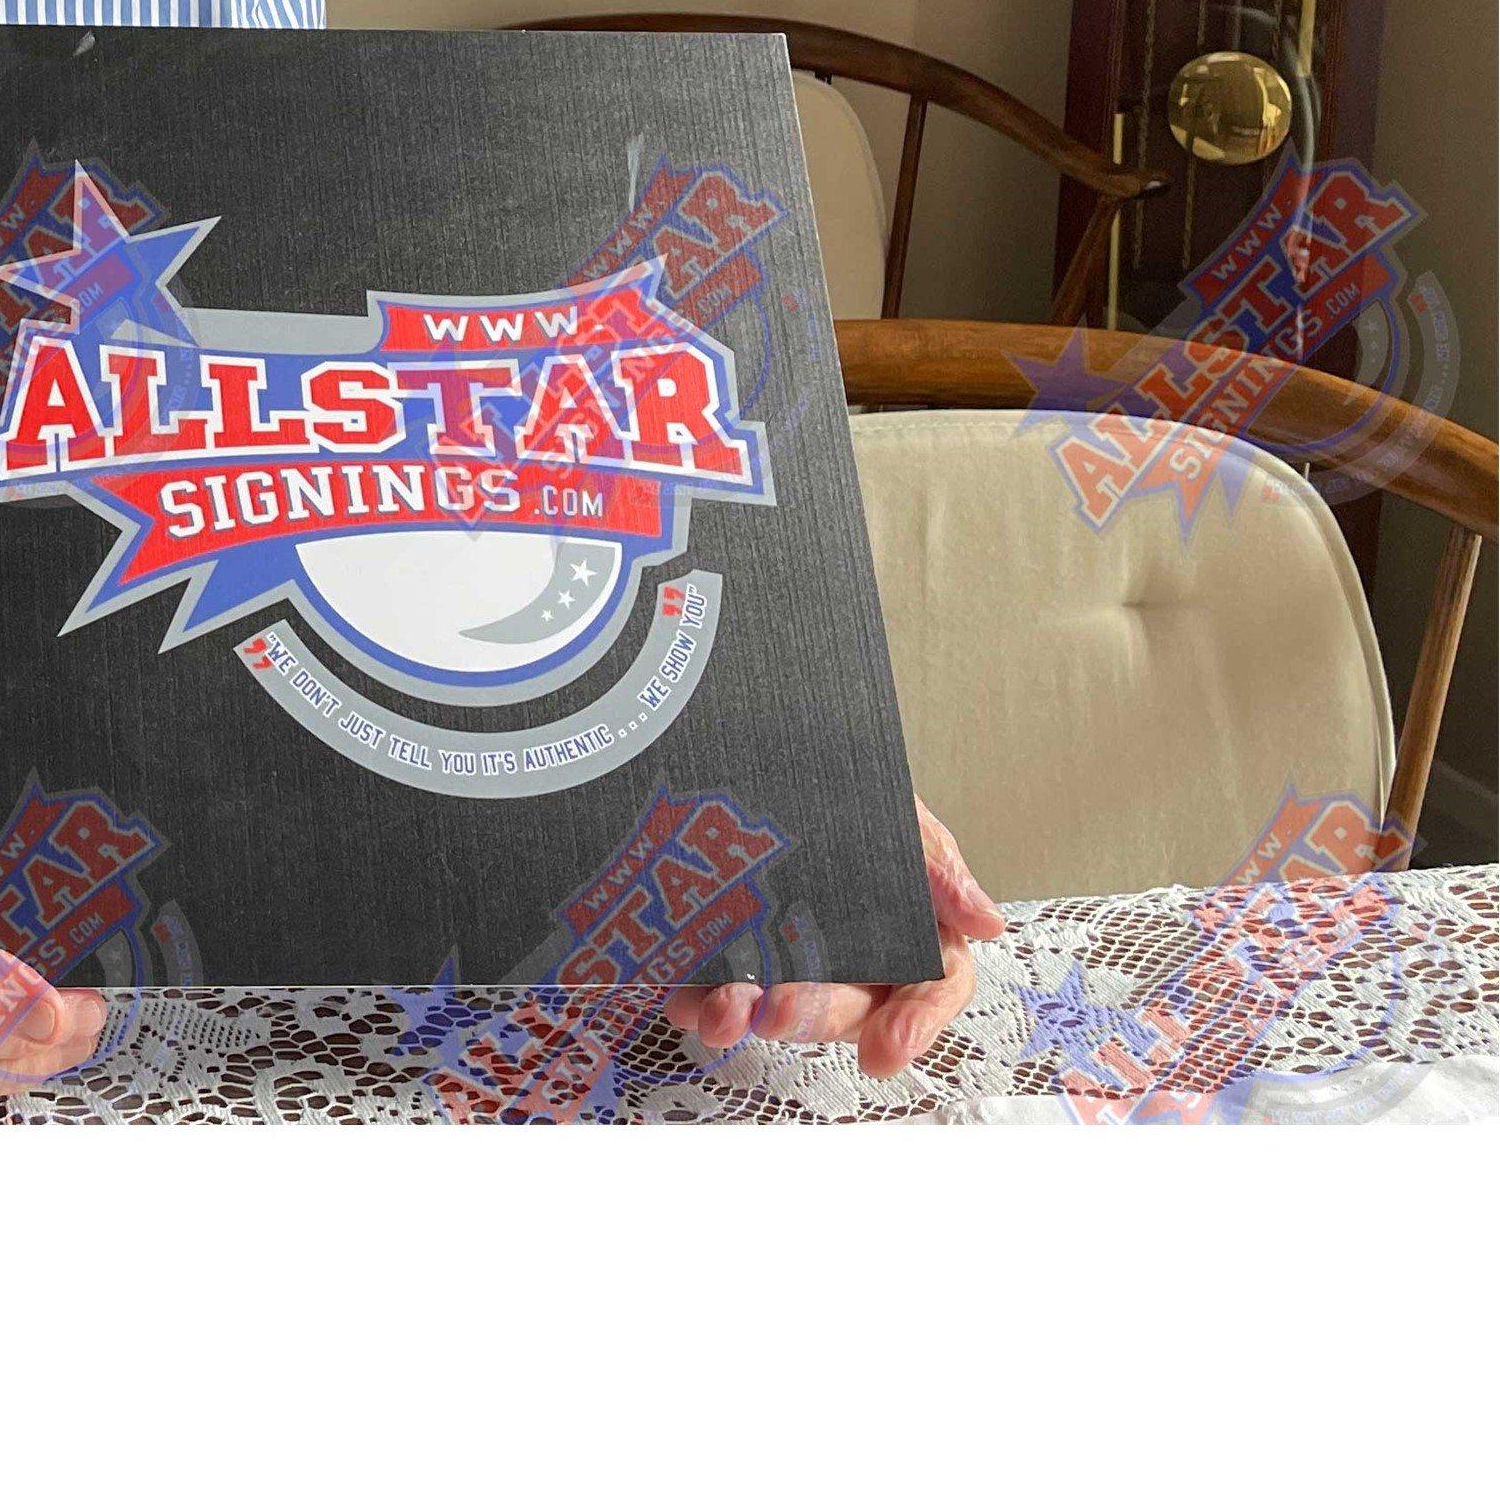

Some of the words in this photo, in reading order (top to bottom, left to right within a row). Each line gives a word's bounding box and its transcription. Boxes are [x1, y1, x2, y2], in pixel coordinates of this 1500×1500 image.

[422, 306, 604, 342] WWW.
[160, 463, 521, 539] SIGNINGS
[533, 485, 603, 518] .COM
[291, 670, 340, 717] DON'T
[340, 712, 385, 748] JUST
[389, 736, 431, 769] TELL
[440, 750, 476, 774] YOU
[482, 752, 517, 774] IT'S
[637, 676, 672, 711] WE
[660, 630, 696, 683] SHOW
